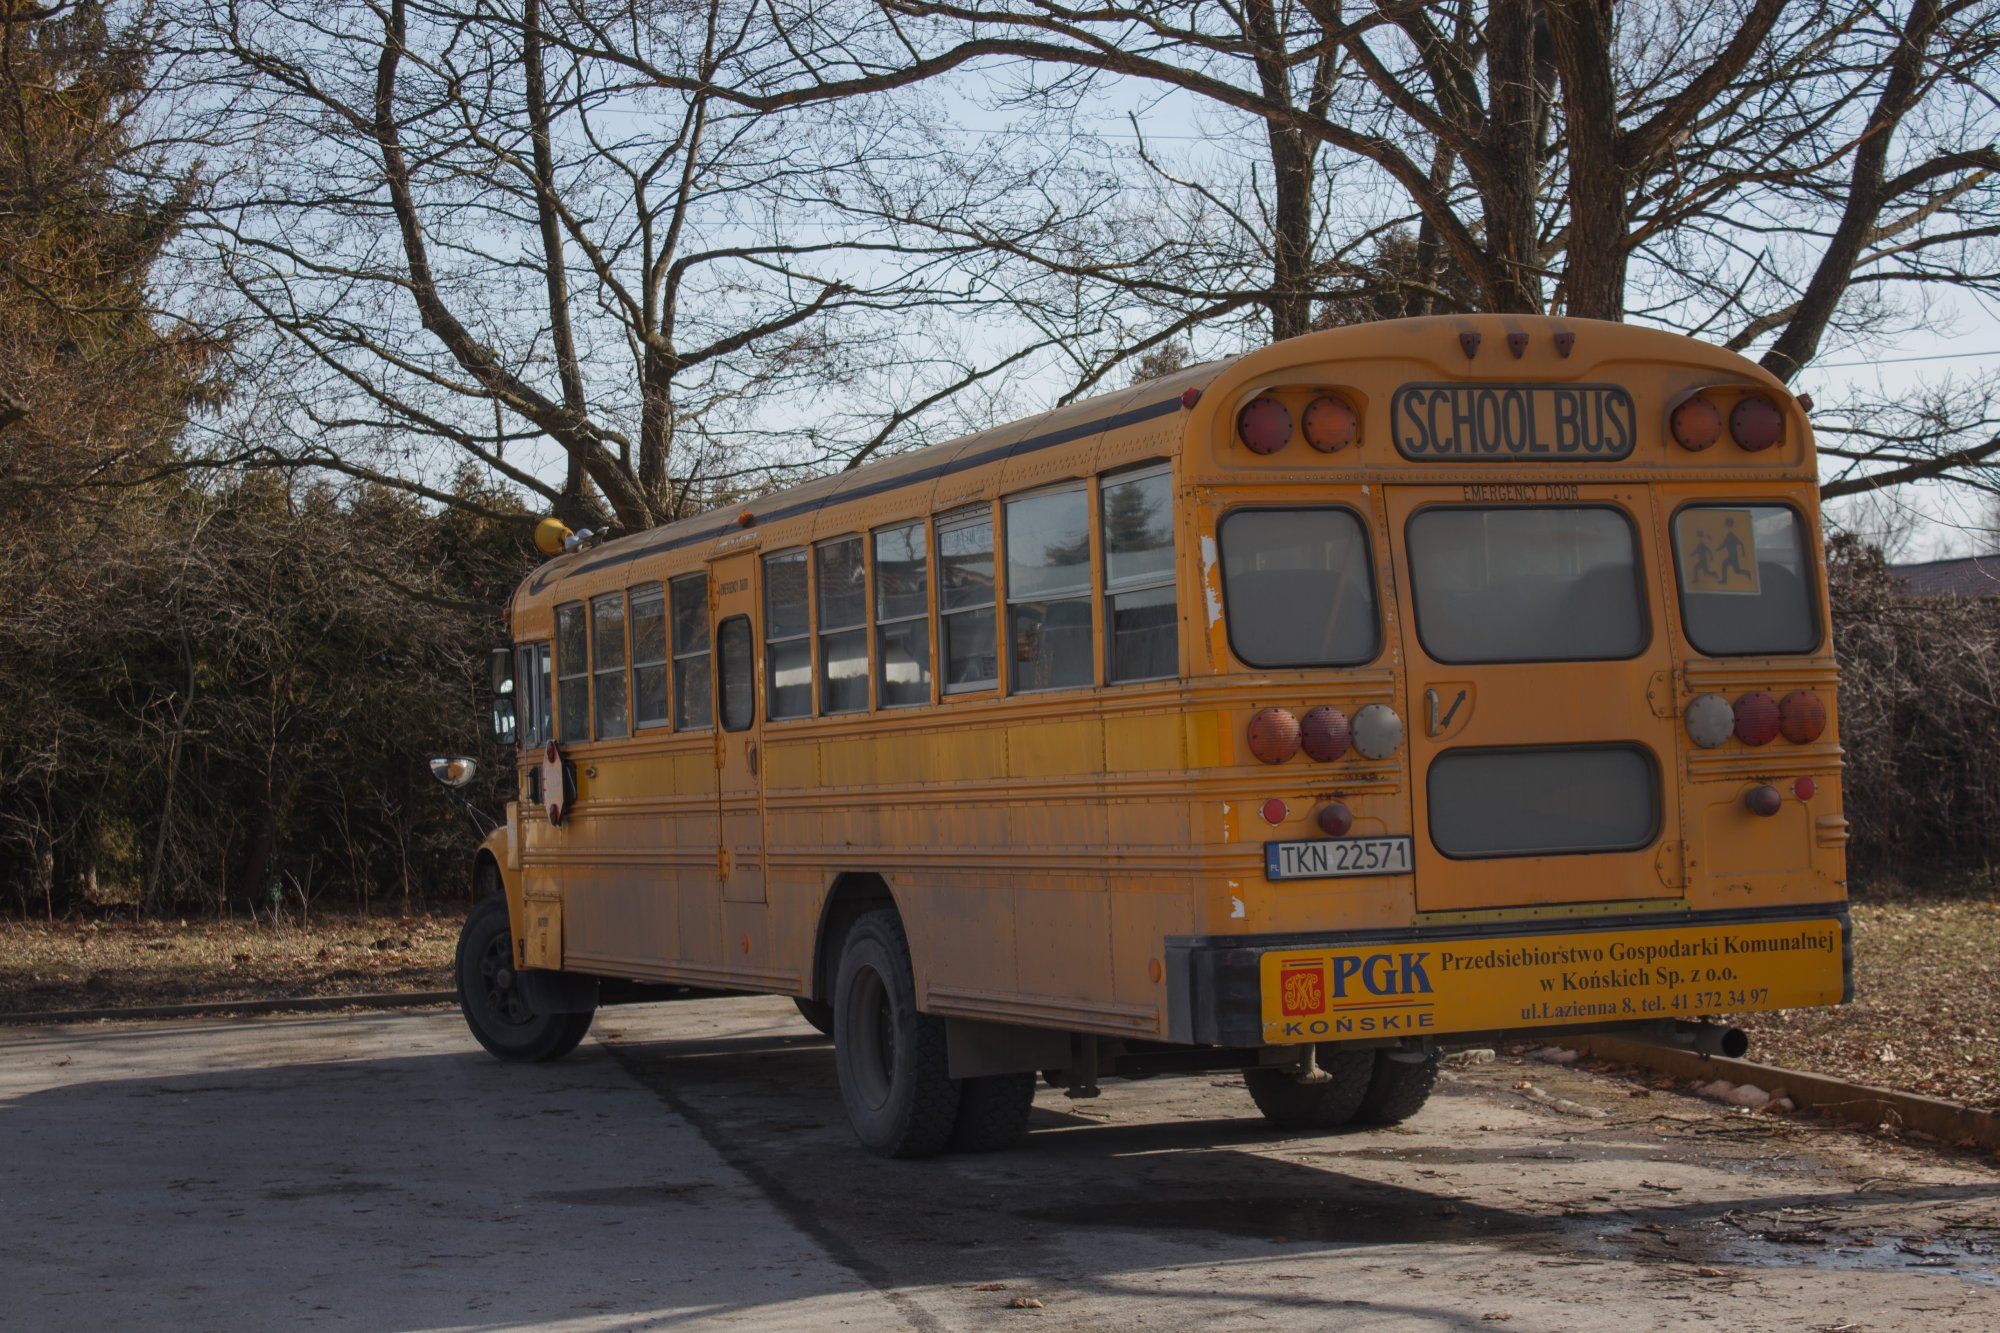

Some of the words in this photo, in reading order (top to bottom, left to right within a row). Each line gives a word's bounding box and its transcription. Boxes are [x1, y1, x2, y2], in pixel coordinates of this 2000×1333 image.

[1404, 389, 1549, 453] SCHOOL
[1554, 390, 1628, 452] BUS
[1463, 484, 1538, 502] EMERGENCY
[1545, 483, 1580, 501] DOOR
[1281, 844, 1328, 873] TKN
[1335, 842, 1406, 871] 22571
[1441, 946, 1604, 971] Przedsiebiorstwo
[1609, 937, 1719, 964] Gospodarki
[1723, 931, 1835, 954] Komunalnej
[1331, 952, 1434, 998] PGK
[1540, 977, 1556, 992] w
[1562, 968, 1650, 991] Końskich
[1656, 967, 1686, 988] Sp.
[1691, 969, 1700, 981] z
[1706, 966, 1738, 981] o.o.
[1622, 998, 1637, 1014] 8,
[1641, 995, 1667, 1011] tel.
[1671, 993, 1689, 1010] 41
[1694, 992, 1722, 1008] 372
[1727, 989, 1746, 1006] 34
[1750, 988, 1769, 1004] 97
[1285, 1013, 1435, 1036] KOŃSKIE
